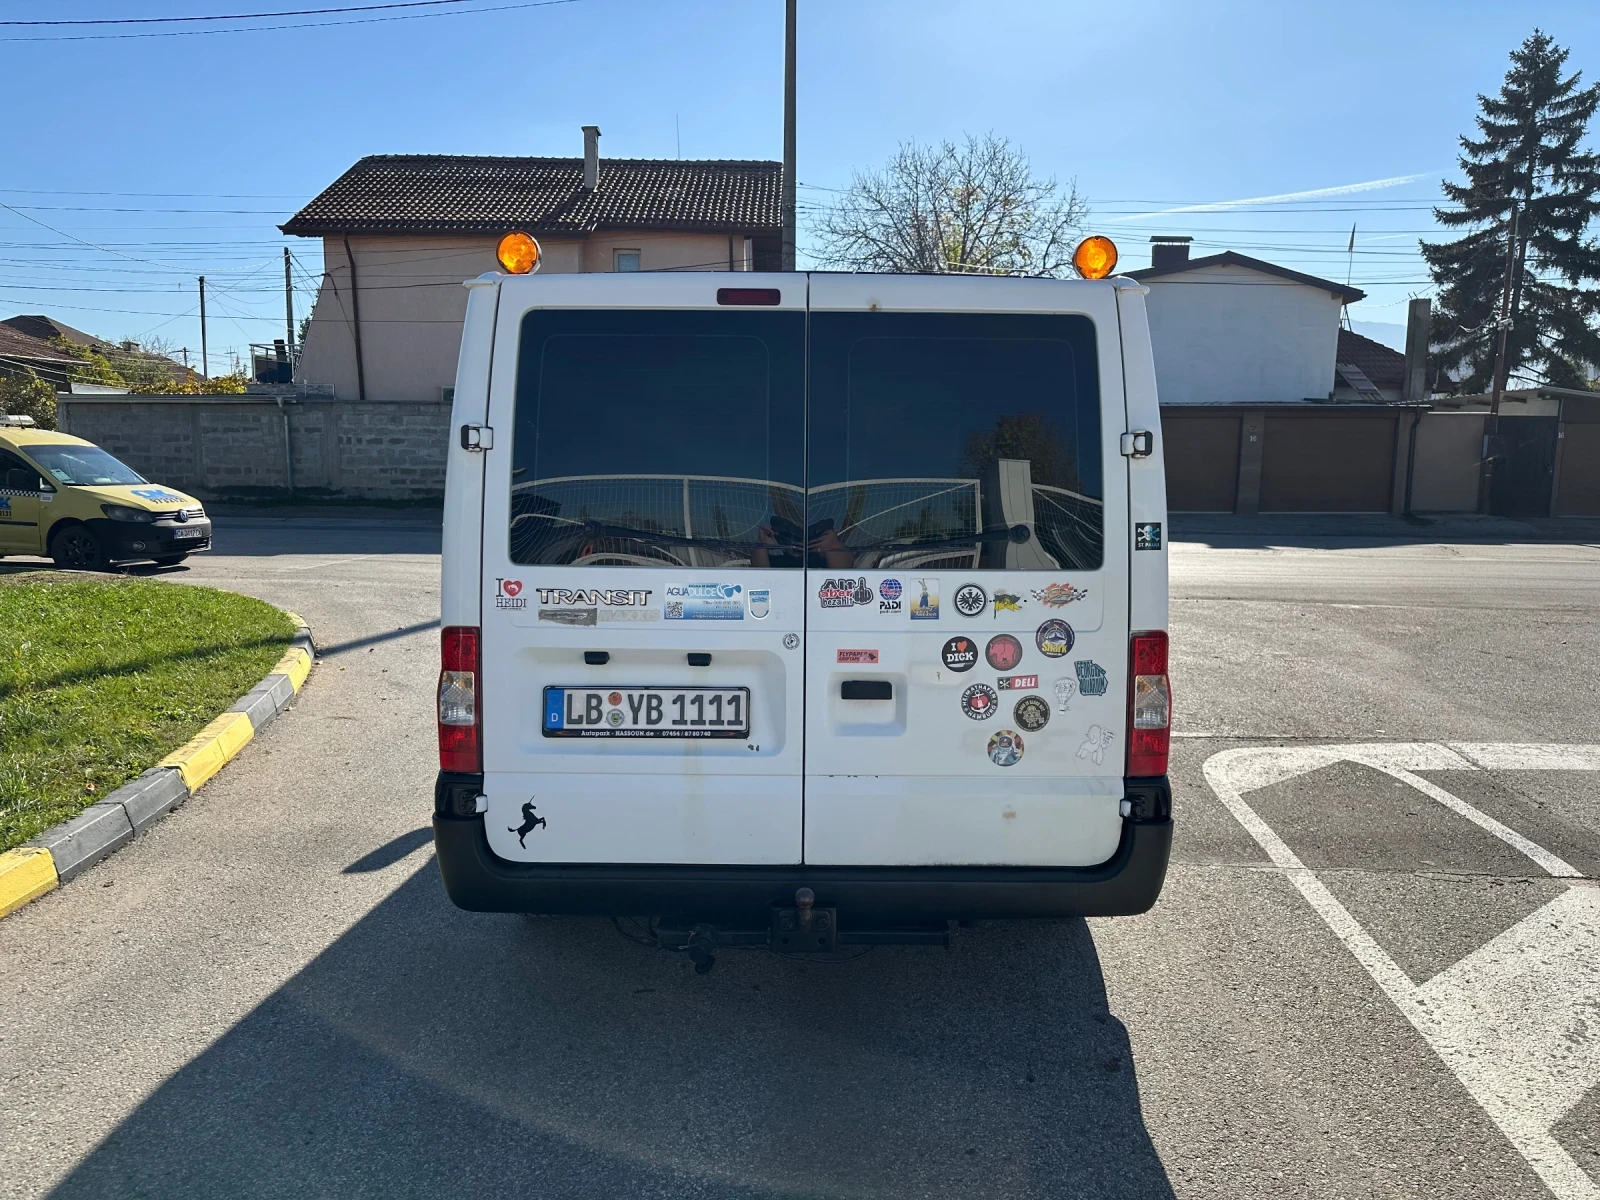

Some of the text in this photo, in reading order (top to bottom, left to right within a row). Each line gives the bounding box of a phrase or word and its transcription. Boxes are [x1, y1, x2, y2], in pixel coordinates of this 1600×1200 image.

[495, 578, 504, 597] I
[666, 587, 717, 597] AGUADULCE
[536, 588, 652, 606] TRANSIT
[820, 589, 853, 598] aber
[495, 598, 527, 608] HEIDI
[821, 597, 854, 608] bezahlt
[879, 601, 902, 610] PADI
[951, 642, 957, 651] I
[1041, 640, 1068, 654] Shark
[946, 652, 974, 663] DICK
[1014, 677, 1036, 688] DELI
[962, 684, 998, 706] HEIMATHAFEN
[566, 693, 744, 726] LB YB 1111
[967, 705, 997, 720] HAMBURG
[551, 712, 559, 722] D
